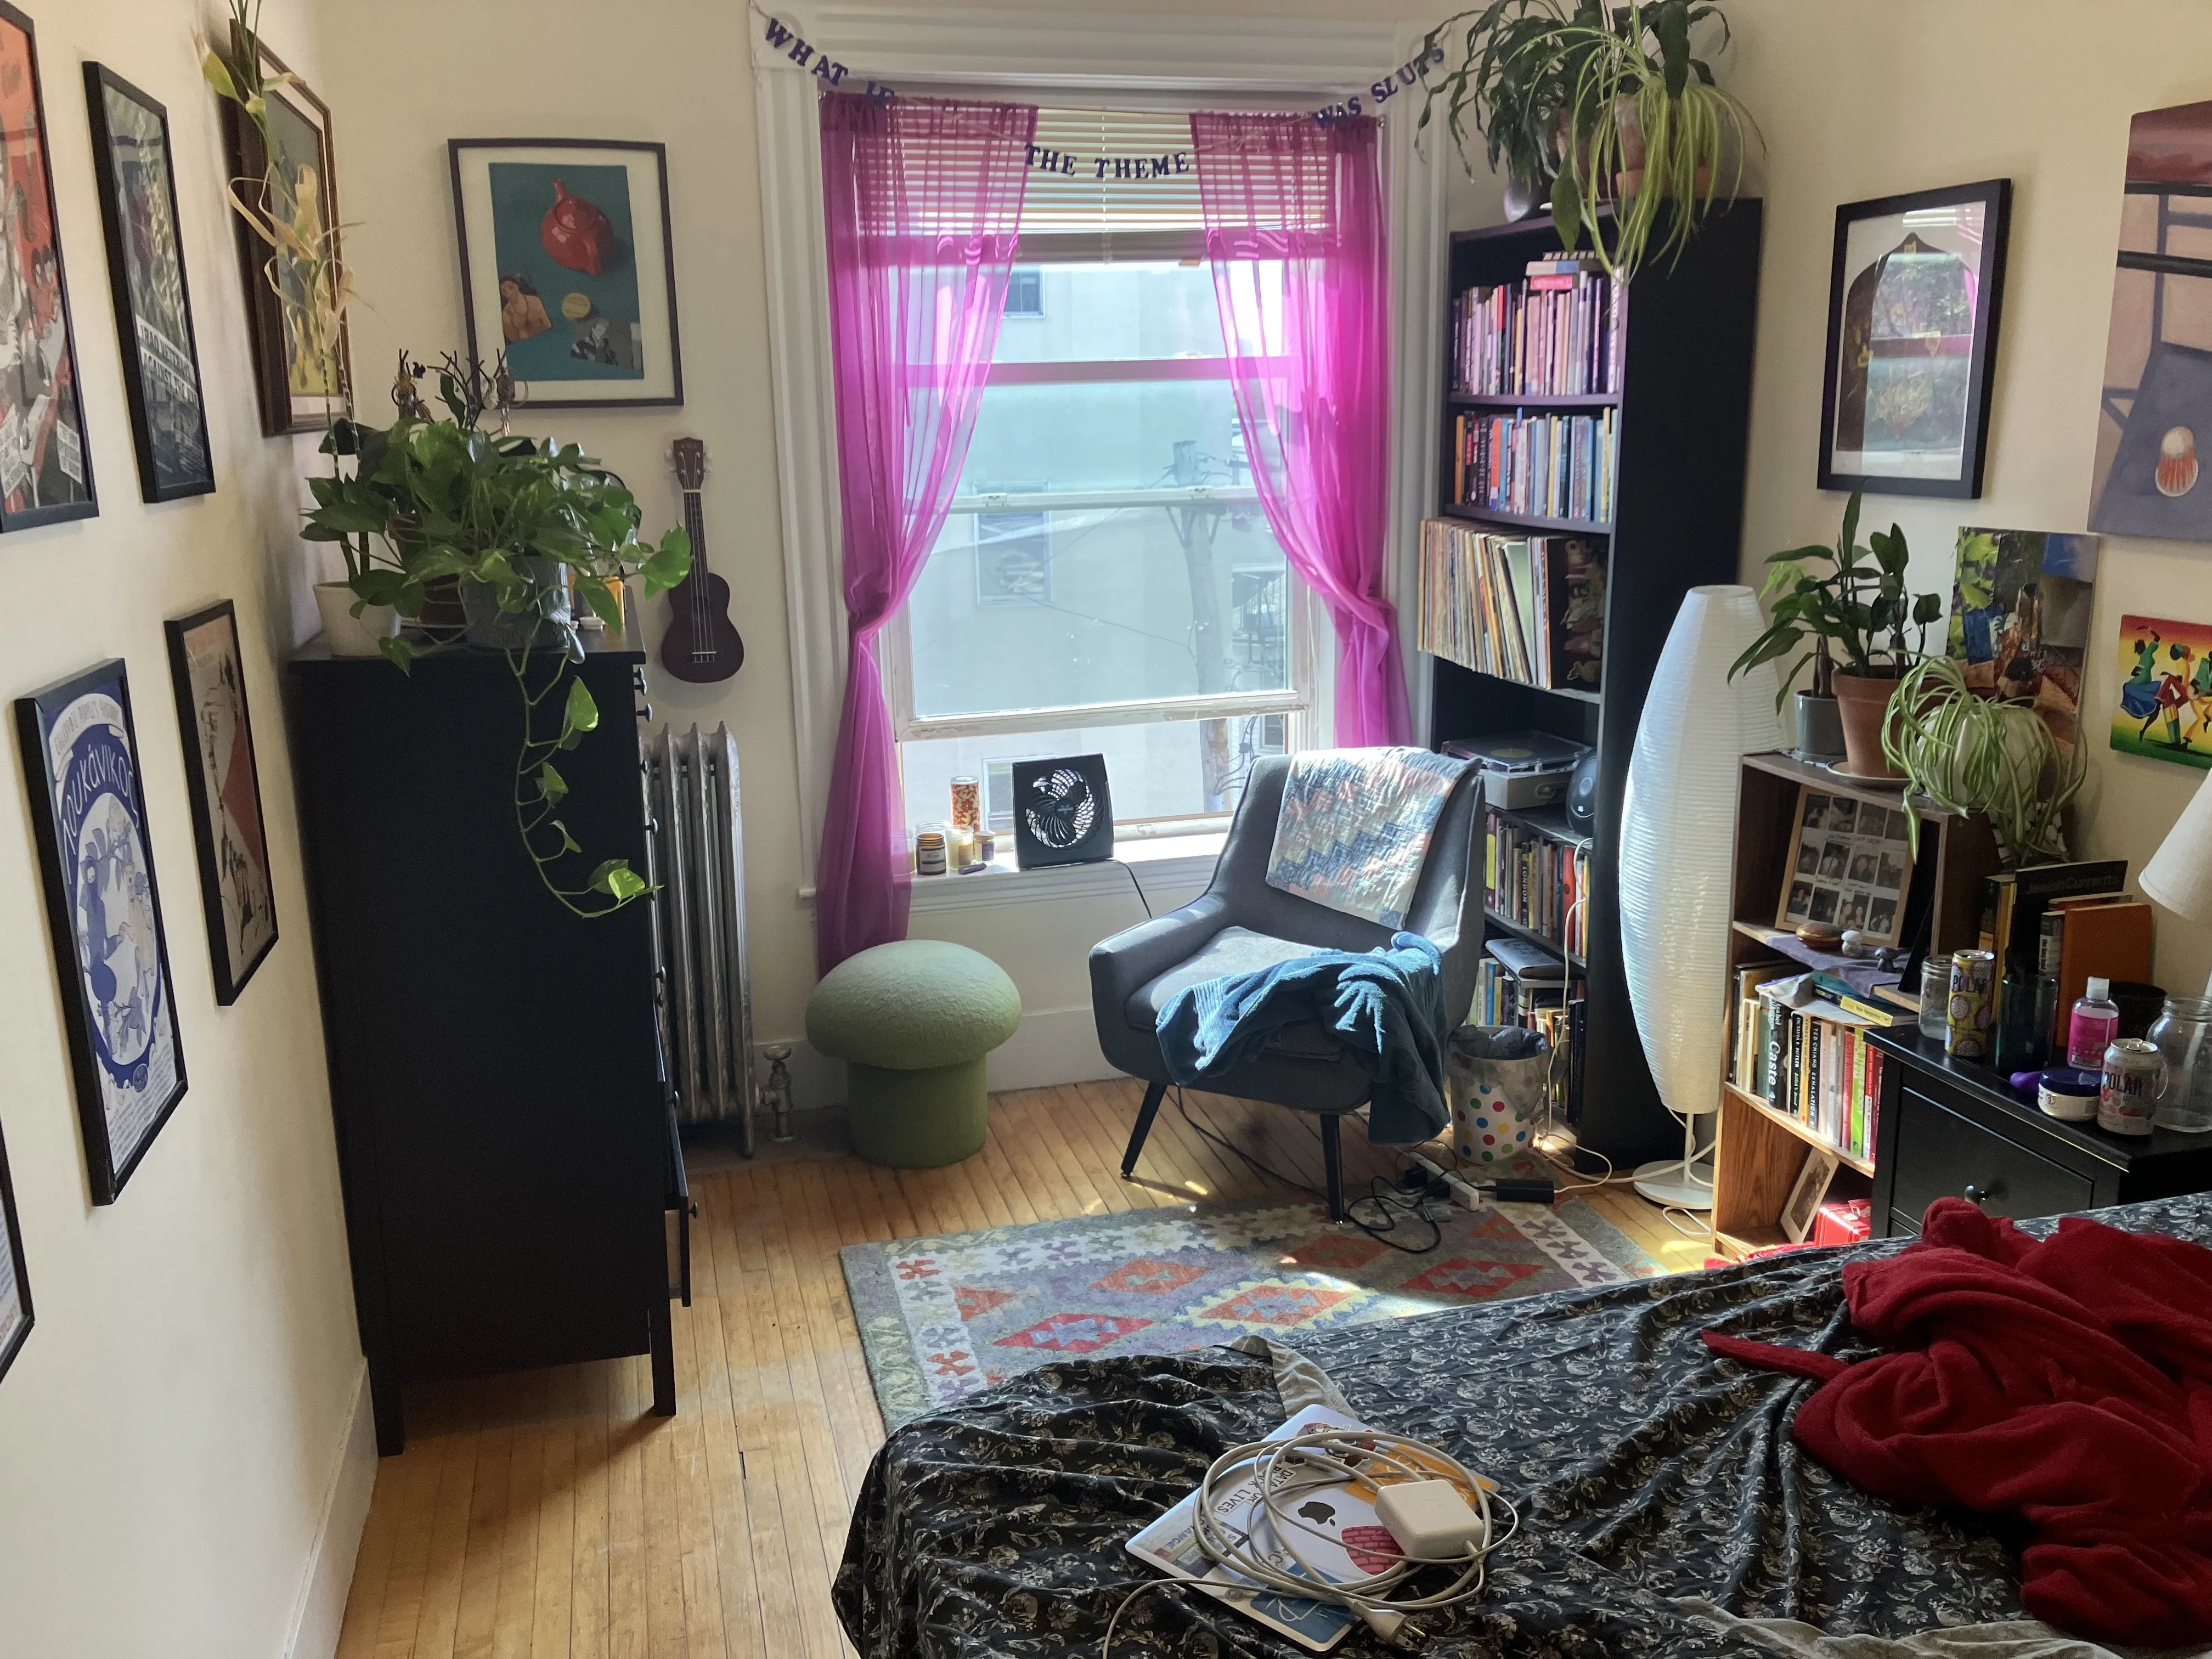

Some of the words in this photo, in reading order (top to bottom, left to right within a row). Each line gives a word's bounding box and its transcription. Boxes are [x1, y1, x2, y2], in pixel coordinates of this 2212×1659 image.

[765, 17, 849, 86] WHAT
[862, 80, 895, 108] IF
[1024, 143, 1077, 176] THE
[1094, 151, 1189, 179] THEME
[1311, 95, 1362, 129] WAS
[1371, 42, 1445, 104] SLUTS
[1953, 975, 1987, 995] POLAR
[1768, 1040, 1781, 1086] Caste
[2102, 1071, 2142, 1097] POLAR
[1270, 1469, 1294, 1488] DATA
[1217, 1488, 1251, 1513] LIVES
